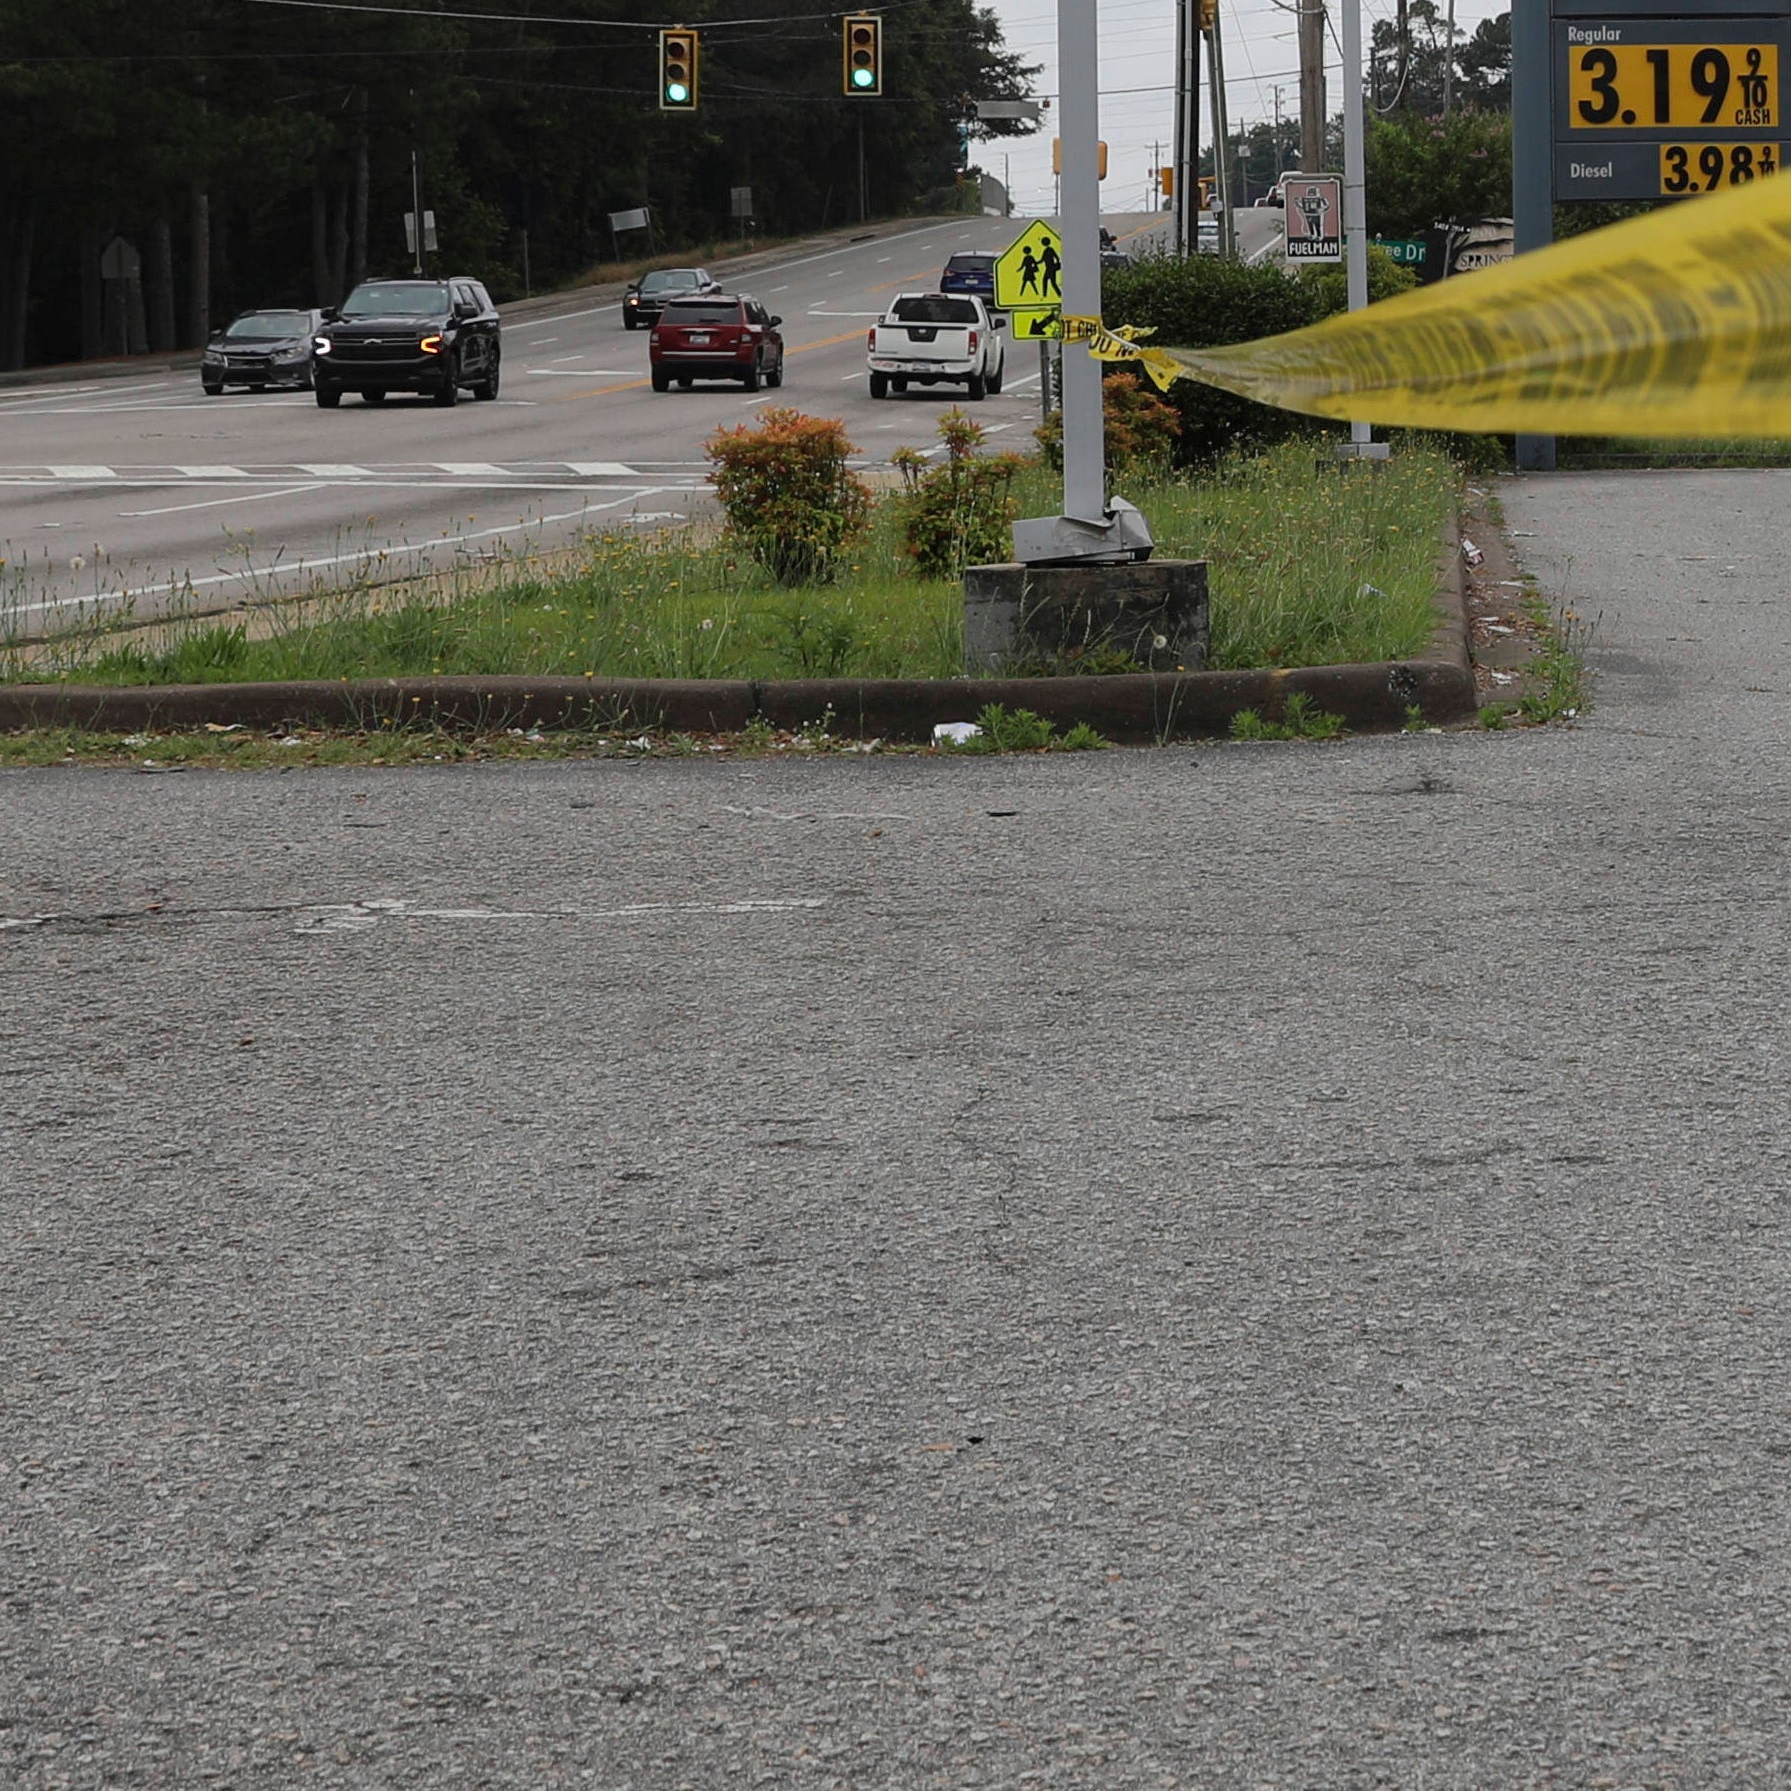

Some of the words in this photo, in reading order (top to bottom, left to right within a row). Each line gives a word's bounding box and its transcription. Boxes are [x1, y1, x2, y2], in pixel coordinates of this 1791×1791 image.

[1568, 25, 1621, 45] Regular
[1578, 47, 1730, 124] 3.19
[1735, 108, 1771, 125] CASH
[1570, 162, 1613, 178] Diesel
[1664, 146, 1755, 193] 3.98
[1289, 241, 1337, 256] FUELMAN
[1406, 244, 1425, 261] Dr
